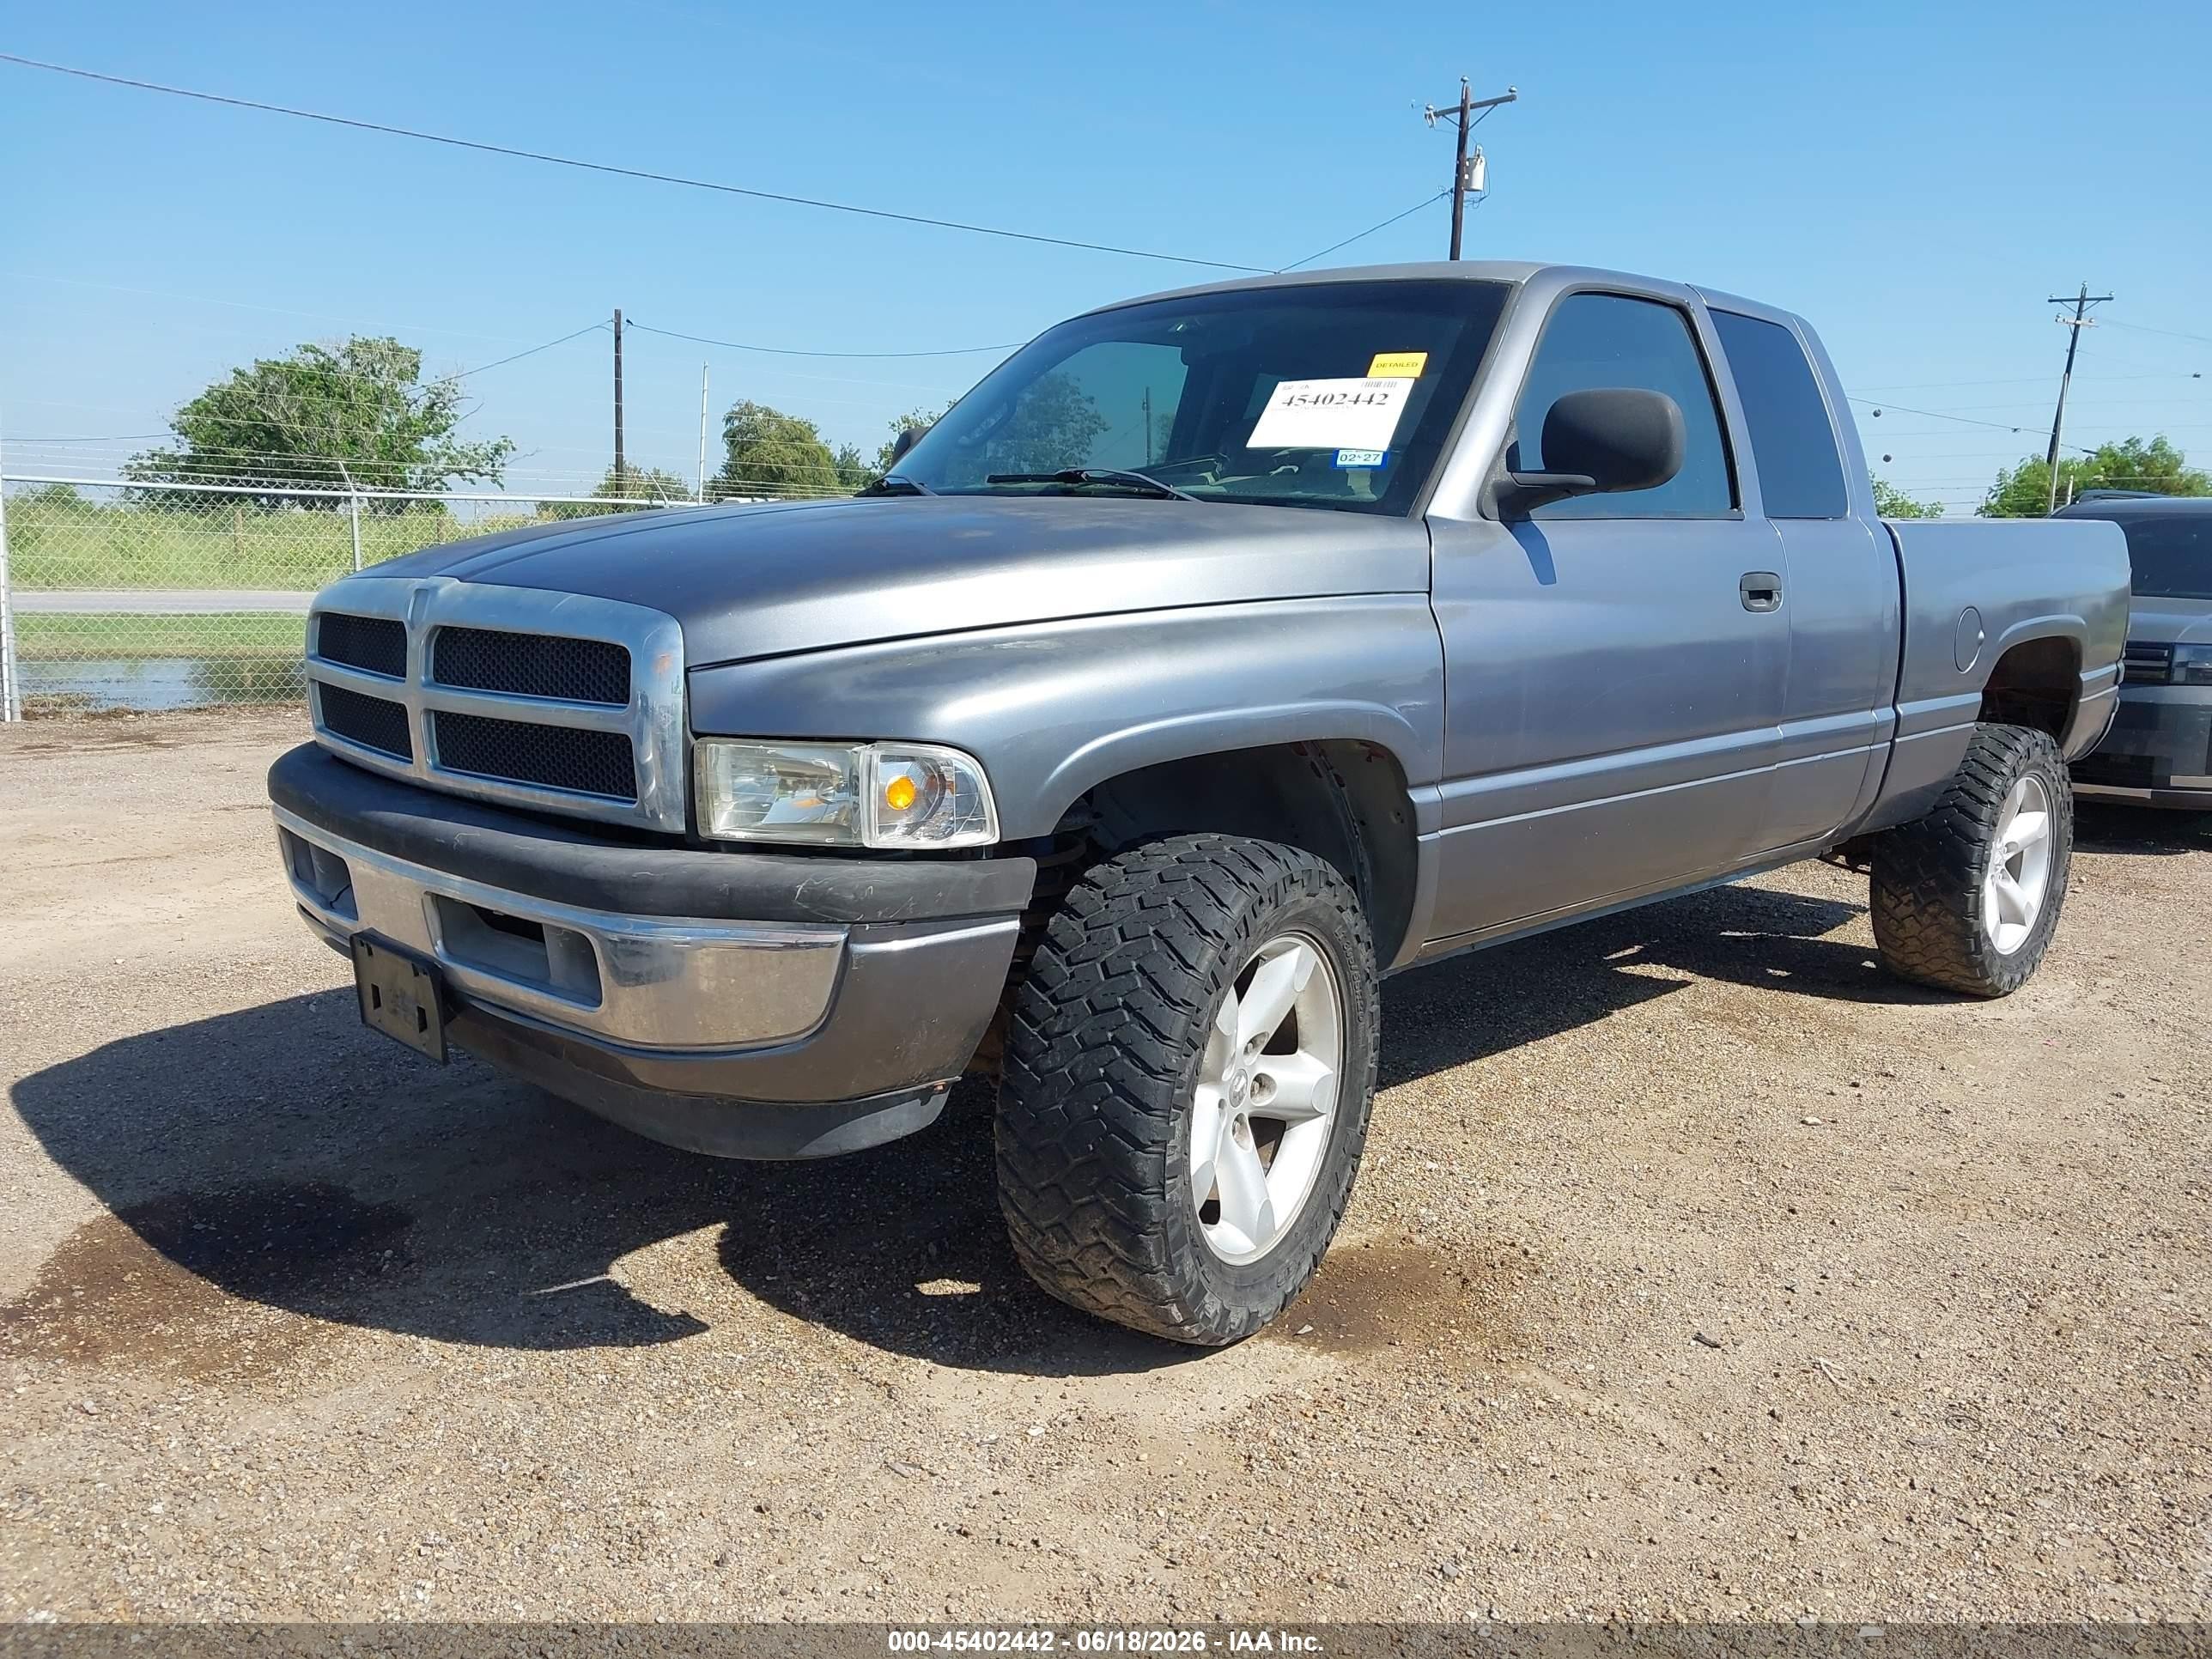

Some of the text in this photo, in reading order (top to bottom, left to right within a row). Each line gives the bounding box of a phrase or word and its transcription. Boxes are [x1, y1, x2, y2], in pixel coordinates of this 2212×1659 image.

[1281, 392, 1389, 407] 45402442
[1340, 453, 1381, 462] 02 27
